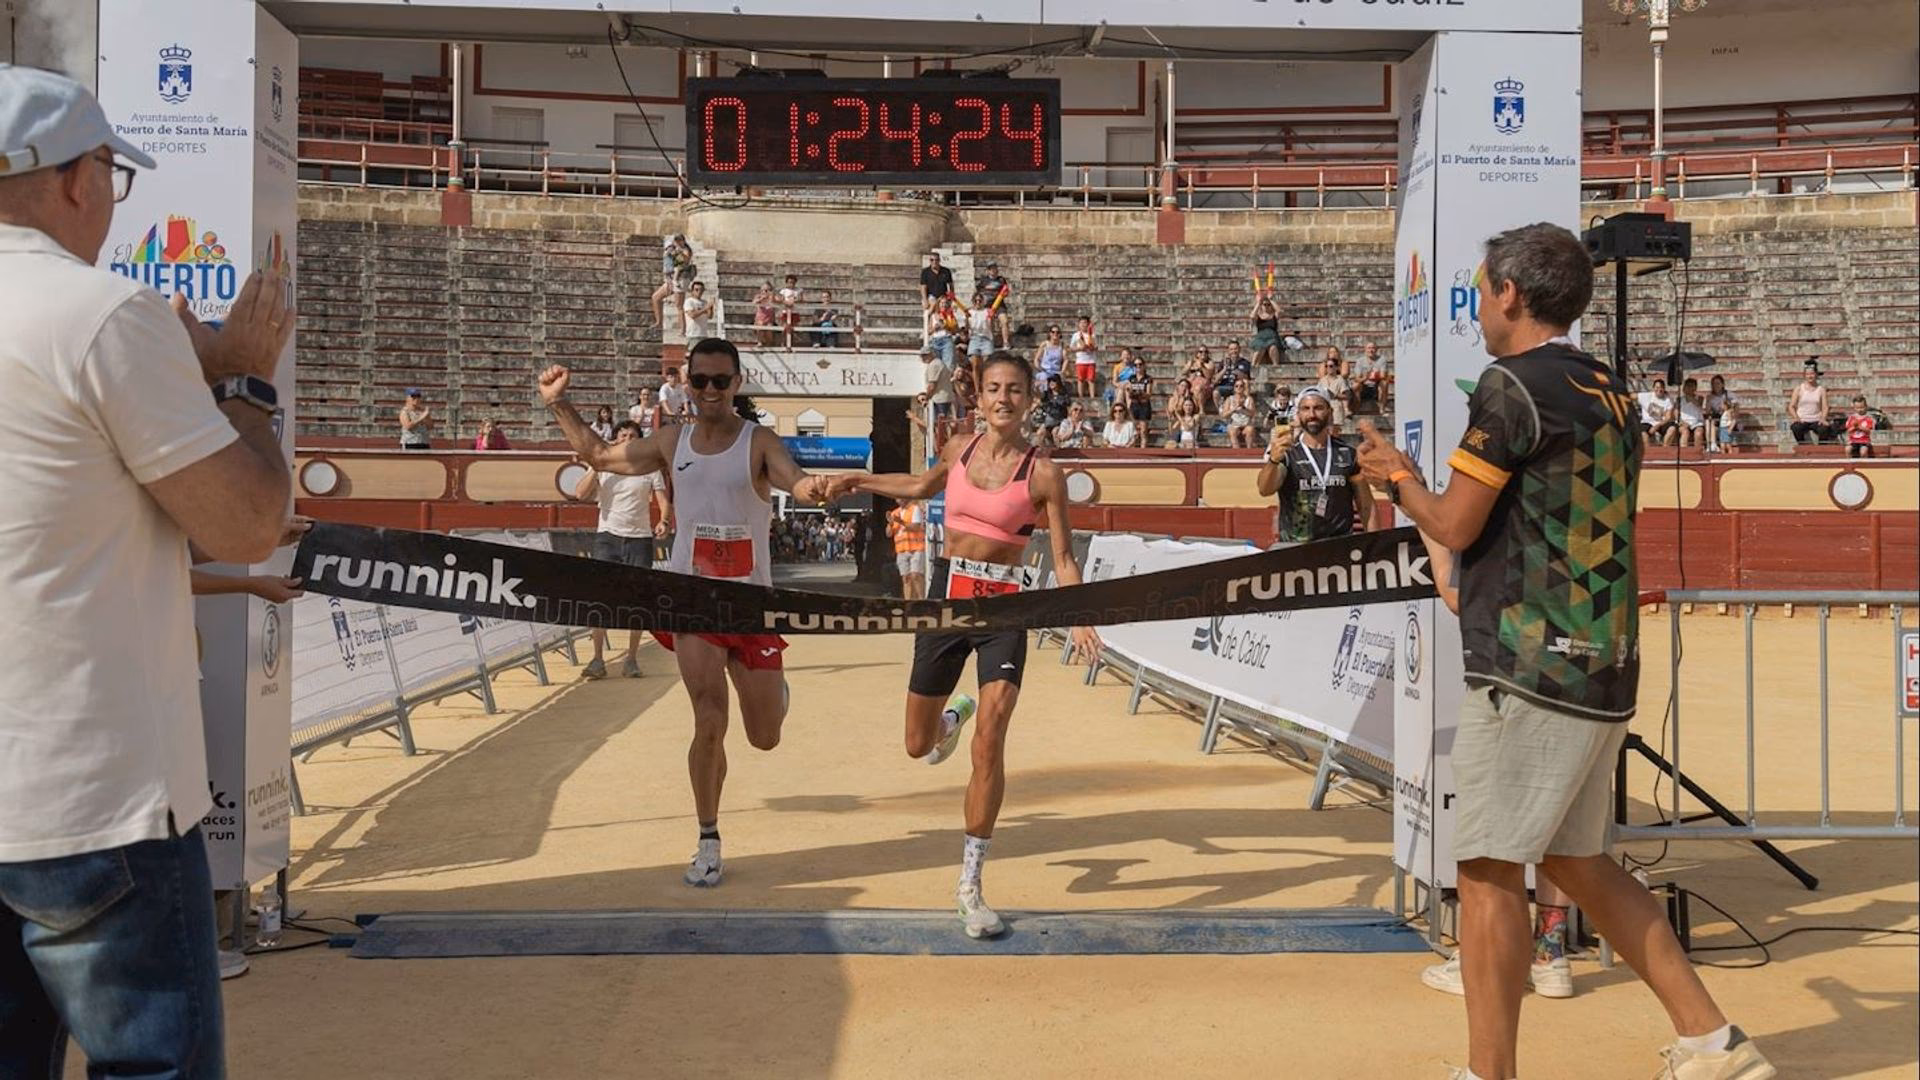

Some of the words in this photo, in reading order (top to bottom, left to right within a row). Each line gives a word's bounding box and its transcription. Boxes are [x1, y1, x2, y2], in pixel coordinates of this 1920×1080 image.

[131, 112, 208, 124] Ayuntamiento
[209, 114, 219, 124] de
[116, 124, 154, 135] Puerto
[157, 125, 172, 135] de
[175, 126, 209, 136] Santa
[213, 125, 248, 137] María
[705, 97, 1044, 171] 01:24:24
[142, 141, 207, 154] DEPORTES
[1468, 143, 1536, 155] Ayuntamiento
[1537, 144, 1549, 154] de
[1441, 154, 1452, 164] El
[1454, 154, 1491, 165] Puerto
[1493, 155, 1507, 165] de
[1509, 155, 1541, 166] Santa
[1544, 154, 1576, 166] María
[1479, 171, 1538, 183] DEPORTES
[745, 367, 820, 387] PUERTA
[841, 368, 894, 387] REAL
[310, 552, 537, 608] runnink.
[763, 607, 988, 632] runnink.
[1222, 626, 1237, 660] de
[1238, 630, 1271, 668] Cádiz
[1360, 653, 1386, 678] Puerto
[201, 815, 235, 826] aces
[208, 831, 235, 841] run
